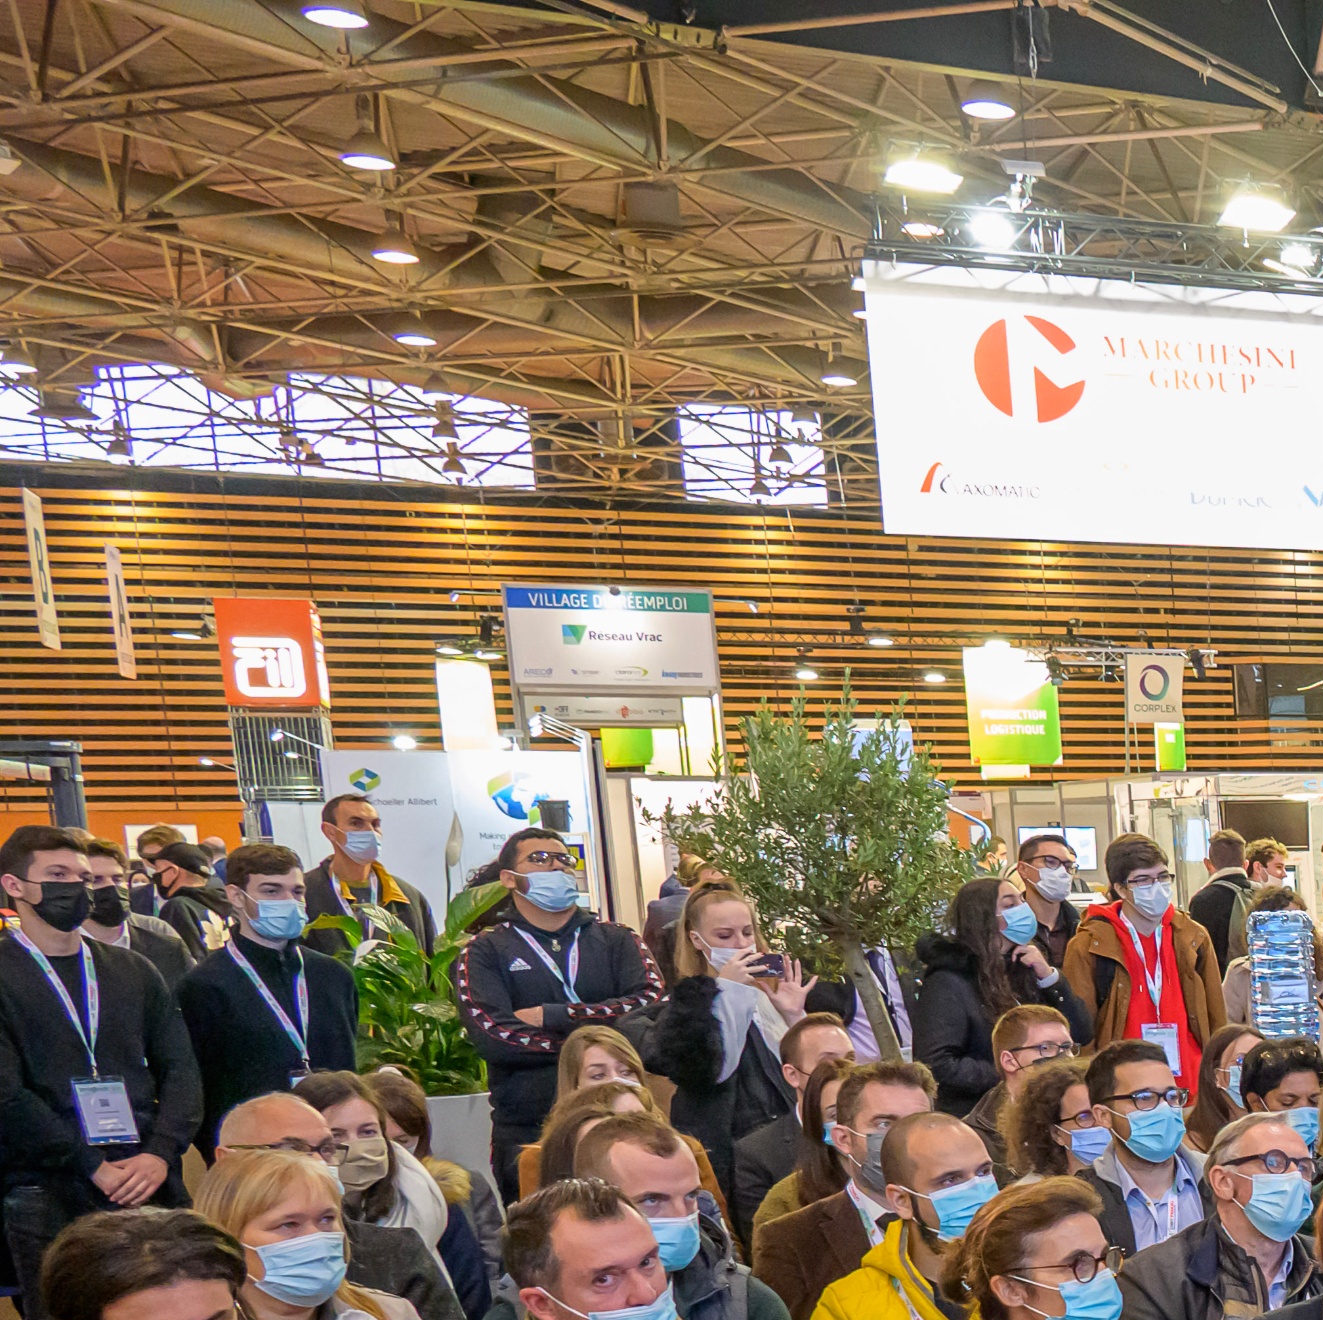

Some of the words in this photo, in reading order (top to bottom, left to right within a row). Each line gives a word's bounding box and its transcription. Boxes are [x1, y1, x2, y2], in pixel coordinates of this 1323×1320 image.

[1103, 336, 1296, 370] MARCHESINI
[1149, 369, 1257, 394] GROUP
[528, 592, 588, 608] VILLAGE
[589, 630, 633, 641] Réseau
[638, 632, 663, 642] Vrac
[1133, 703, 1177, 713] CORPLEX
[984, 724, 1046, 735] LOGISTIQUE
[368, 798, 405, 806] choeller
[408, 797, 438, 806] Allibert
[479, 832, 506, 843] Making
